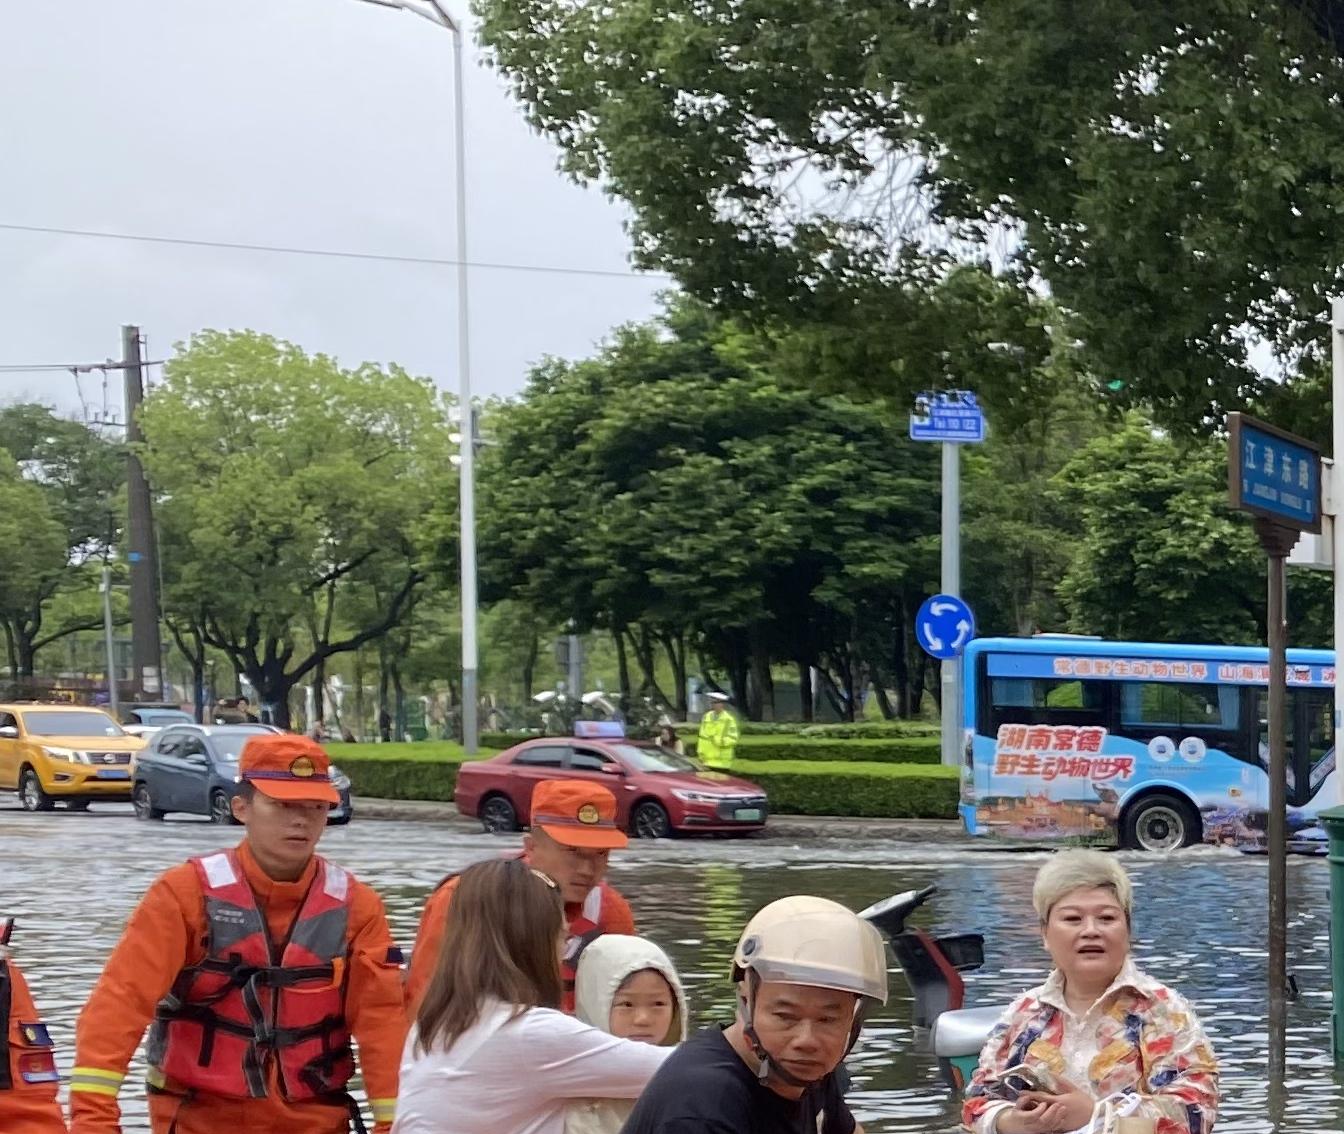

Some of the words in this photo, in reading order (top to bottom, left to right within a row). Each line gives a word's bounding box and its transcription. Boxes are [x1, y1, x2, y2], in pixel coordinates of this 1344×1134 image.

[1054, 657, 1207, 680] 常德野生动物世界
[998, 724, 1106, 752] 湖南常德
[994, 755, 1136, 781] 野生动物世界
